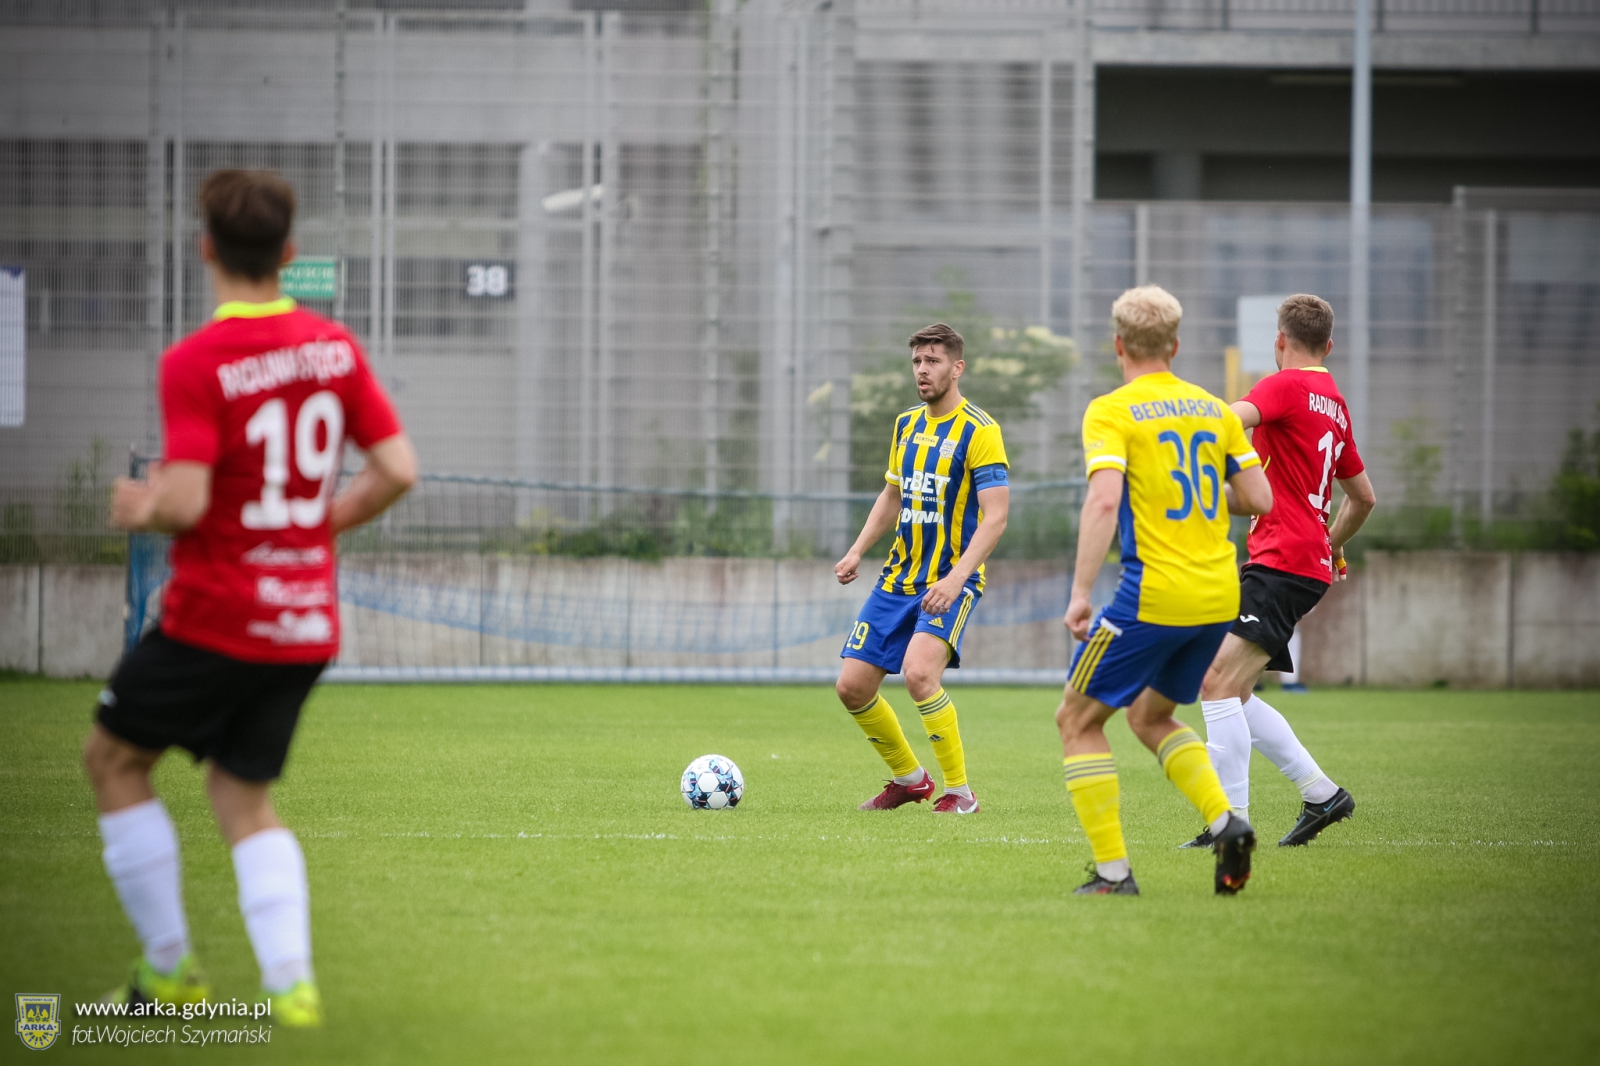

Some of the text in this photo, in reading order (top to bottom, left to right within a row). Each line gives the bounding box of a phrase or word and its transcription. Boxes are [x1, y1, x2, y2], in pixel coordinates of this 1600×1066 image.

[466, 264, 508, 297] 38
[1129, 399, 1223, 422] BEDNARSKI
[241, 390, 344, 529] 19
[1158, 430, 1220, 521] 36
